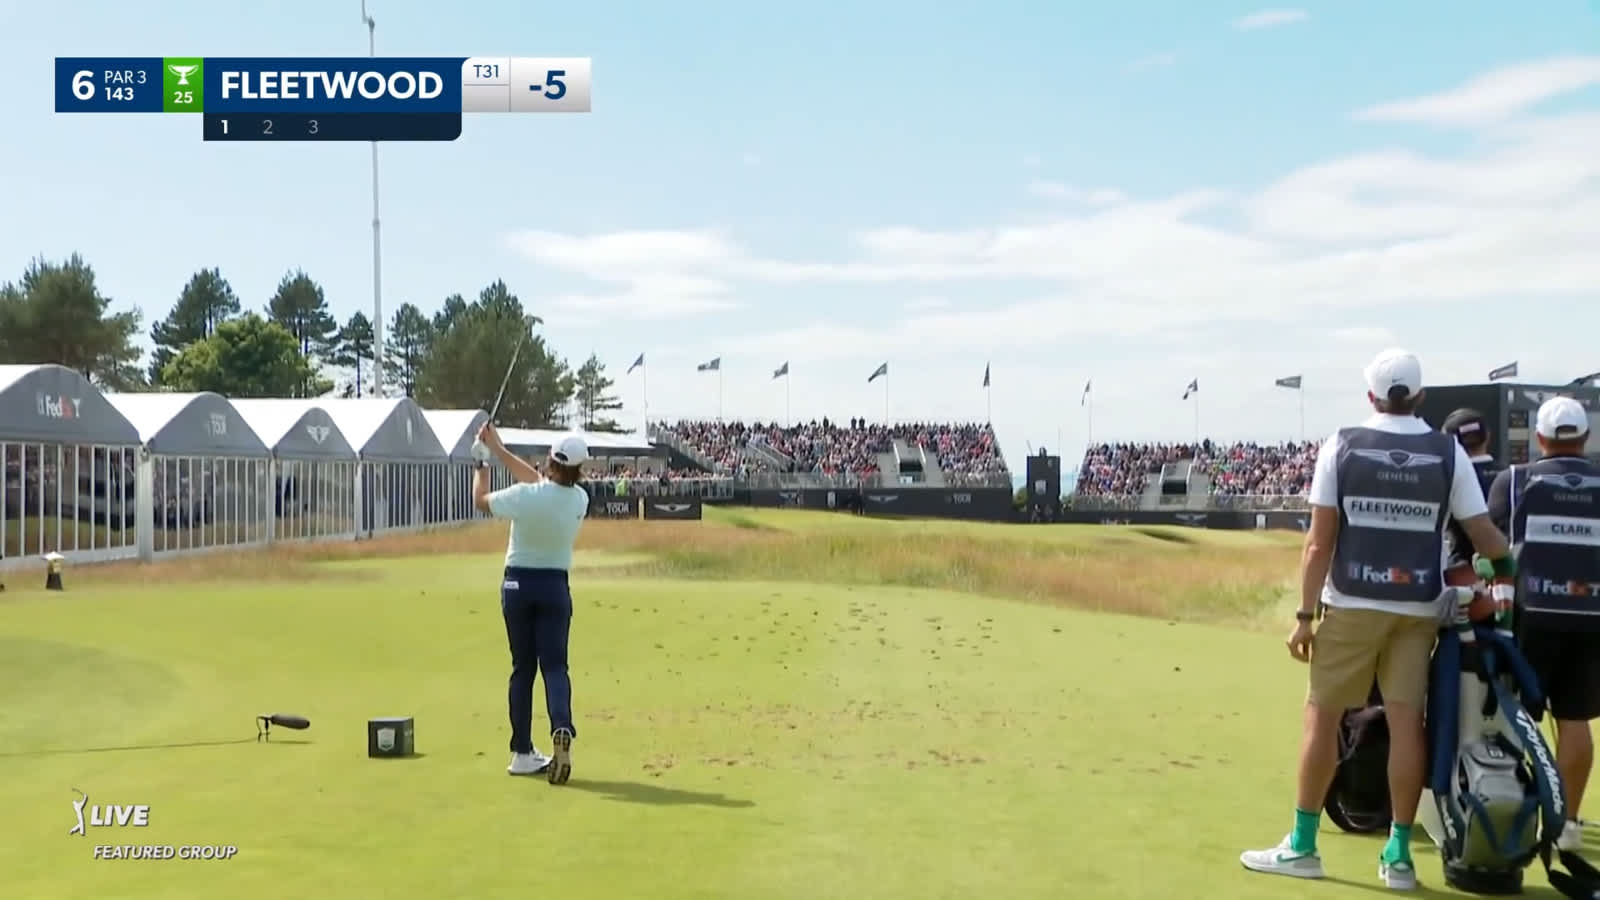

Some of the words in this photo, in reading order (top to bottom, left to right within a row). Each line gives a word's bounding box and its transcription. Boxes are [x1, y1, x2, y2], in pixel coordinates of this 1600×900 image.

[1350, 500, 1432, 517] FLEETWOOD
[1551, 523, 1592, 536] CLARK
[1362, 565, 1411, 584] FedEx
